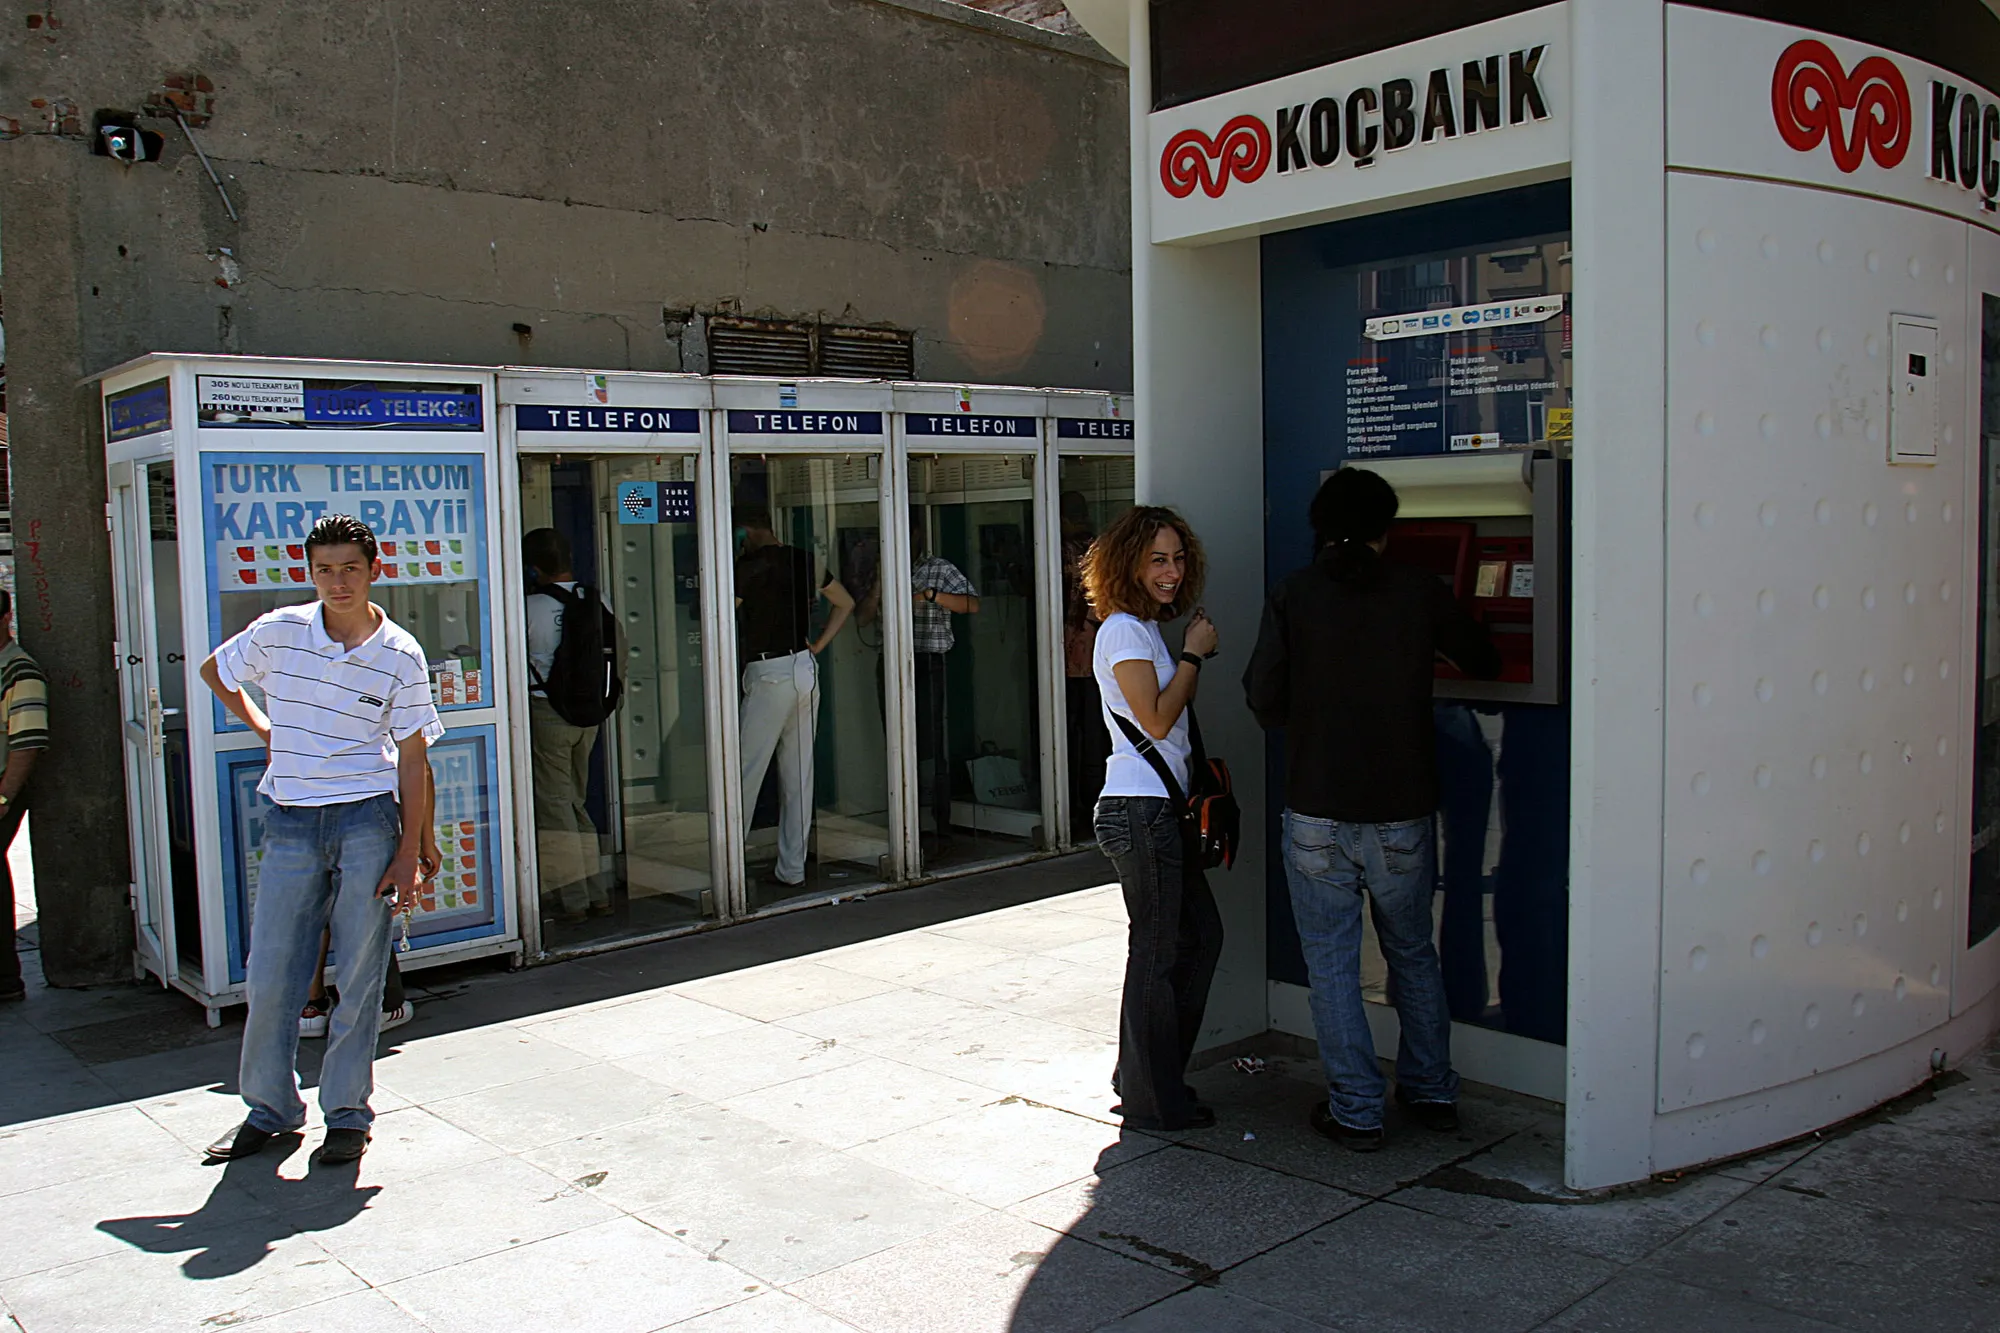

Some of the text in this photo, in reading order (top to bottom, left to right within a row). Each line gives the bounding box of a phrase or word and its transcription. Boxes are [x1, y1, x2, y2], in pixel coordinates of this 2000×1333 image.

[1276, 43, 1552, 175] KOÇBANK
[251, 382, 282, 390] TELEKART
[211, 393, 231, 401] 260
[251, 395, 282, 404] TELEKART
[379, 398, 475, 418] TELEKOM
[548, 410, 671, 429] TELEFON
[754, 414, 858, 431] TELEFON
[928, 417, 1016, 434] TELEFON
[1077, 421, 1131, 437] TELEF
[1453, 438, 1469, 447] ATM
[325, 464, 469, 493] TELEKOM
[665, 499, 690, 507] TELE
[215, 500, 328, 541] KART
[665, 508, 690, 517] KOM
